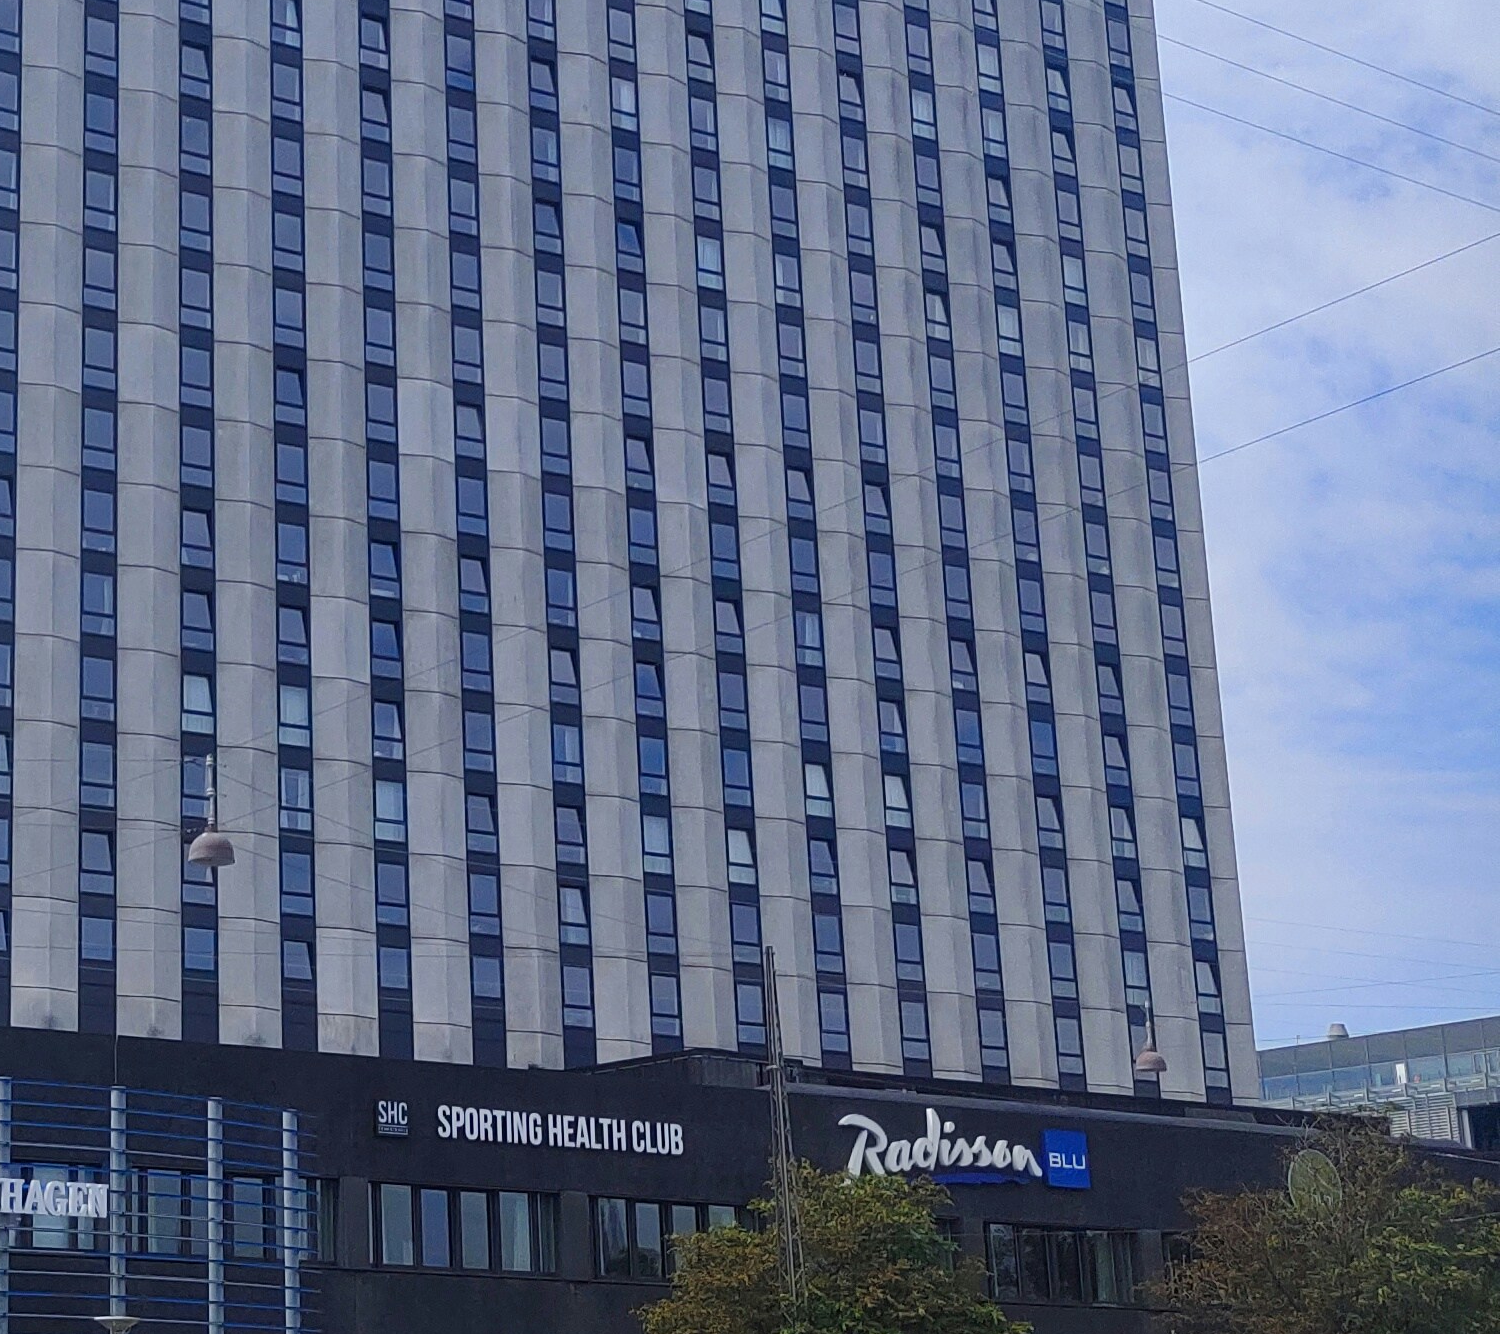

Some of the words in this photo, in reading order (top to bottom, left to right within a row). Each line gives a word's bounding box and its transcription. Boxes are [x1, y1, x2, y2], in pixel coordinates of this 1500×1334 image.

[378, 1100, 408, 1125] SHC
[437, 1104, 543, 1146] SPORTING
[547, 1113, 627, 1152] HEALTH
[631, 1120, 684, 1156] CLUB
[838, 1107, 1043, 1178] Radisson
[1049, 1152, 1086, 1169] BLU
